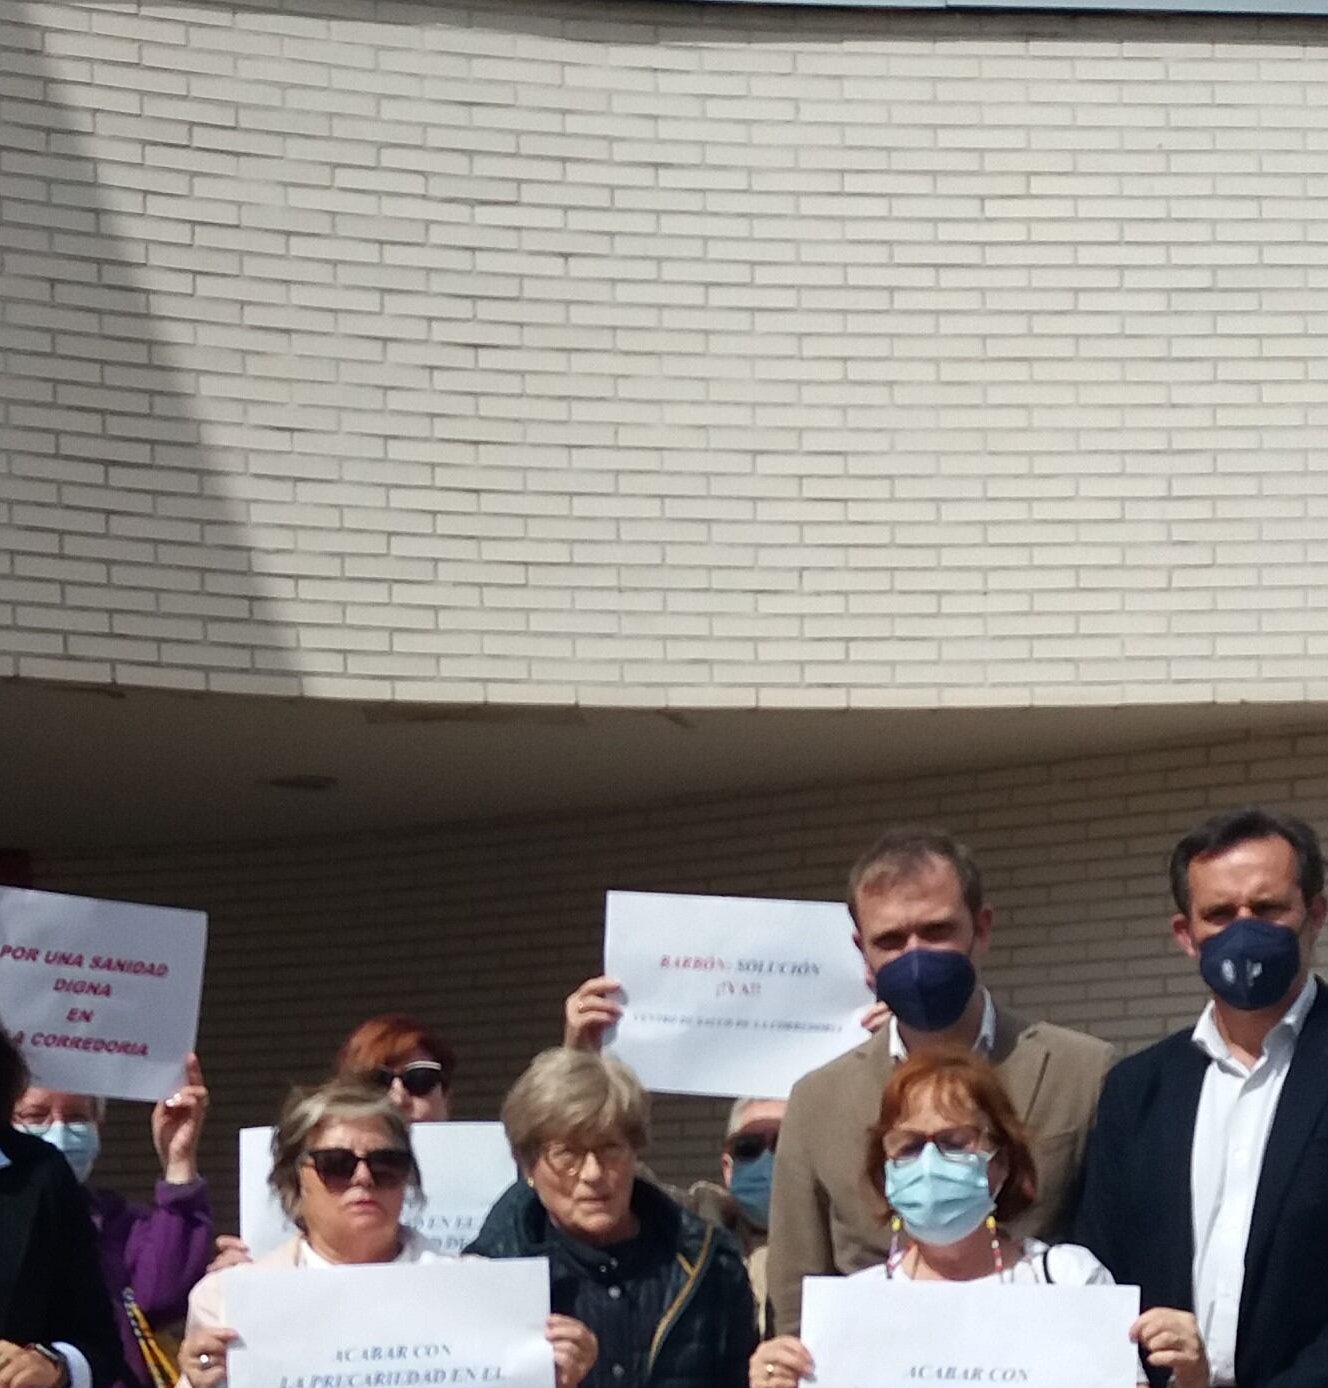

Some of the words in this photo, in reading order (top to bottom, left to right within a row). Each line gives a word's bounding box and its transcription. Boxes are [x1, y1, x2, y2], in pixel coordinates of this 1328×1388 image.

[0, 944, 39, 961] POR
[44, 950, 84, 967] UNA
[89, 955, 169, 977] SANIDAD
[53, 978, 112, 997] DIGNA
[66, 1008, 94, 1022] EN
[30, 1032, 149, 1056] CORREDORIA
[335, 1345, 408, 1362] ACABAR
[413, 1344, 452, 1359] CON
[451, 1367, 478, 1382] EN
[482, 1366, 504, 1380] EL
[908, 1366, 983, 1381] ACABAR
[989, 1367, 1031, 1382] CON
